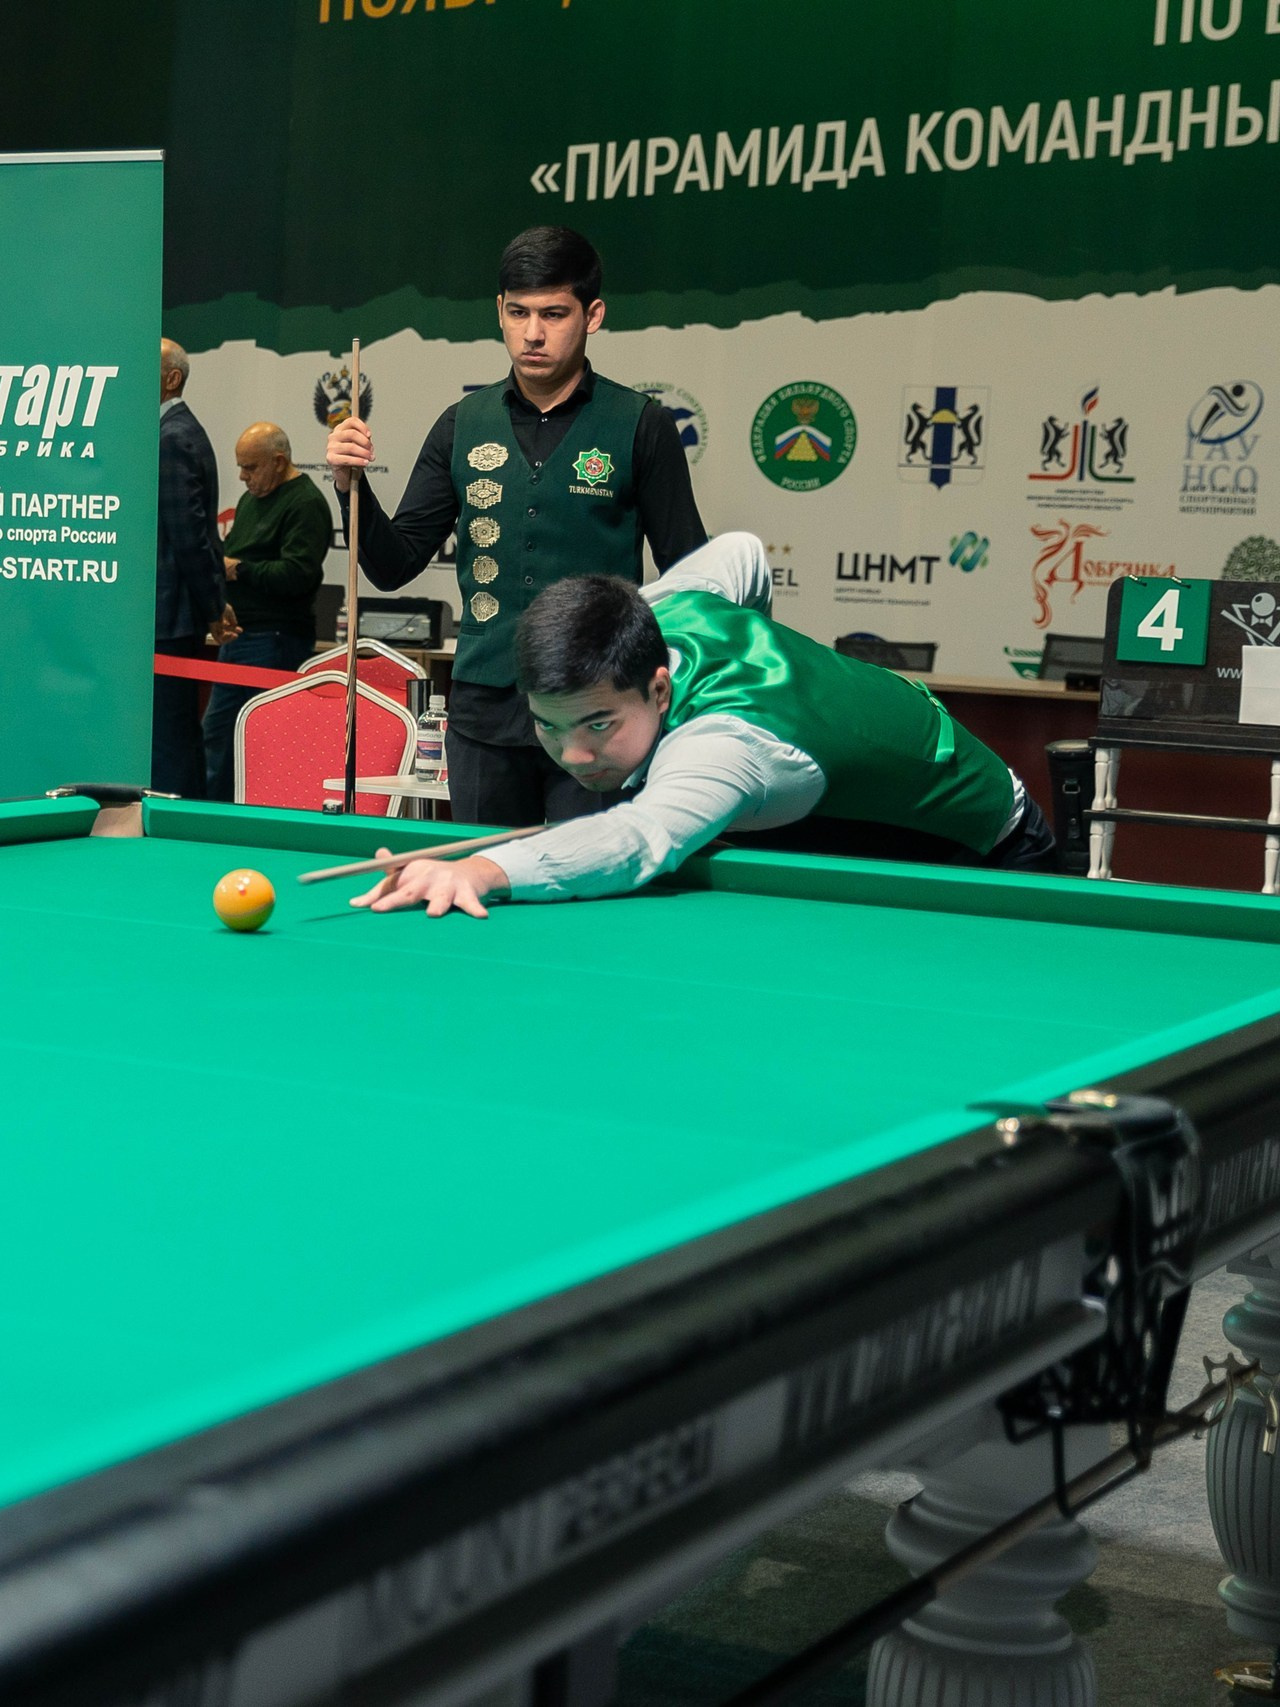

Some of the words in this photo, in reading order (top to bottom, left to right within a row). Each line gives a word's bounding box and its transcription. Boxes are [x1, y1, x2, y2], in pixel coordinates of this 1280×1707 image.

[530, 117, 886, 203] «ПИРАМИДА
[11, 493, 121, 520] ПАРТНЕР
[569, 485, 614, 499] TURKMENISTAN
[6, 528, 57, 545] спорта
[61, 526, 117, 544] России
[835, 552, 940, 585] ЦНМТ
[1137, 588, 1184, 652] 4
